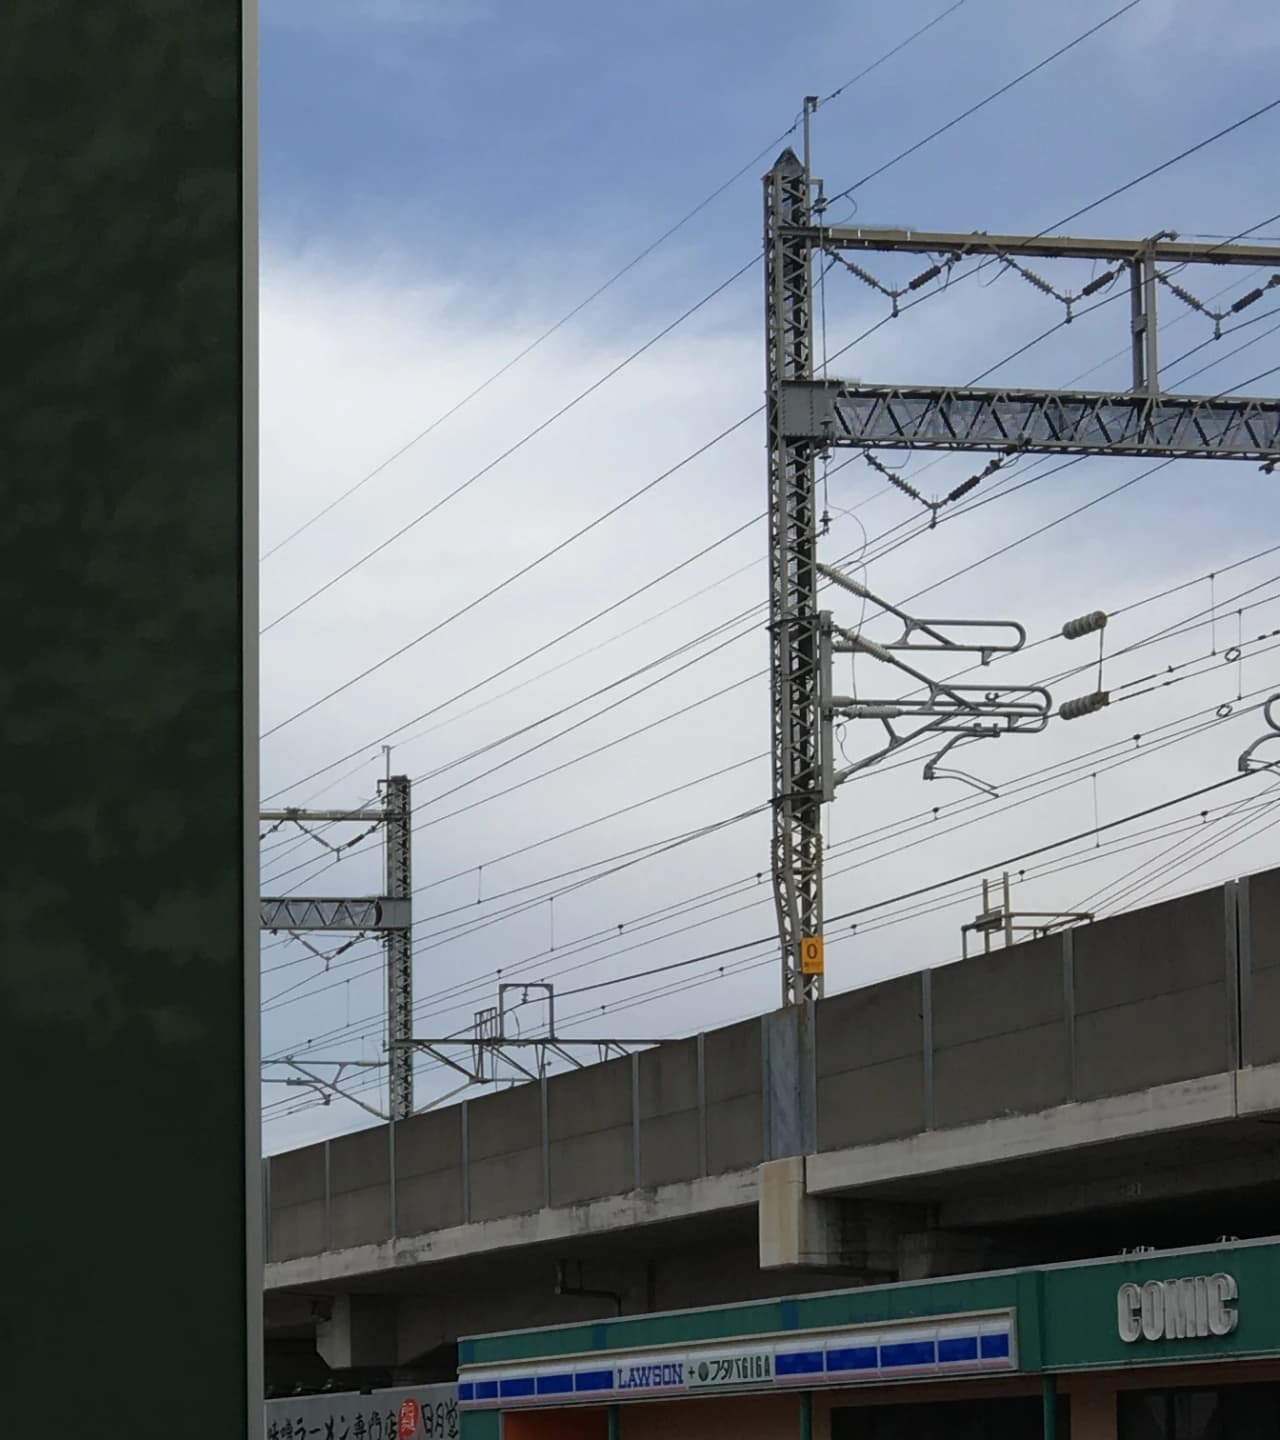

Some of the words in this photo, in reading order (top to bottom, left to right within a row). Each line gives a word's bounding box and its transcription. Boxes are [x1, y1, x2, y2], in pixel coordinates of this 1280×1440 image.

[1117, 1272, 1238, 1343] COMIC
[617, 1363, 684, 1389] LAWSON
[421, 1397, 459, 1439] 日月堂
